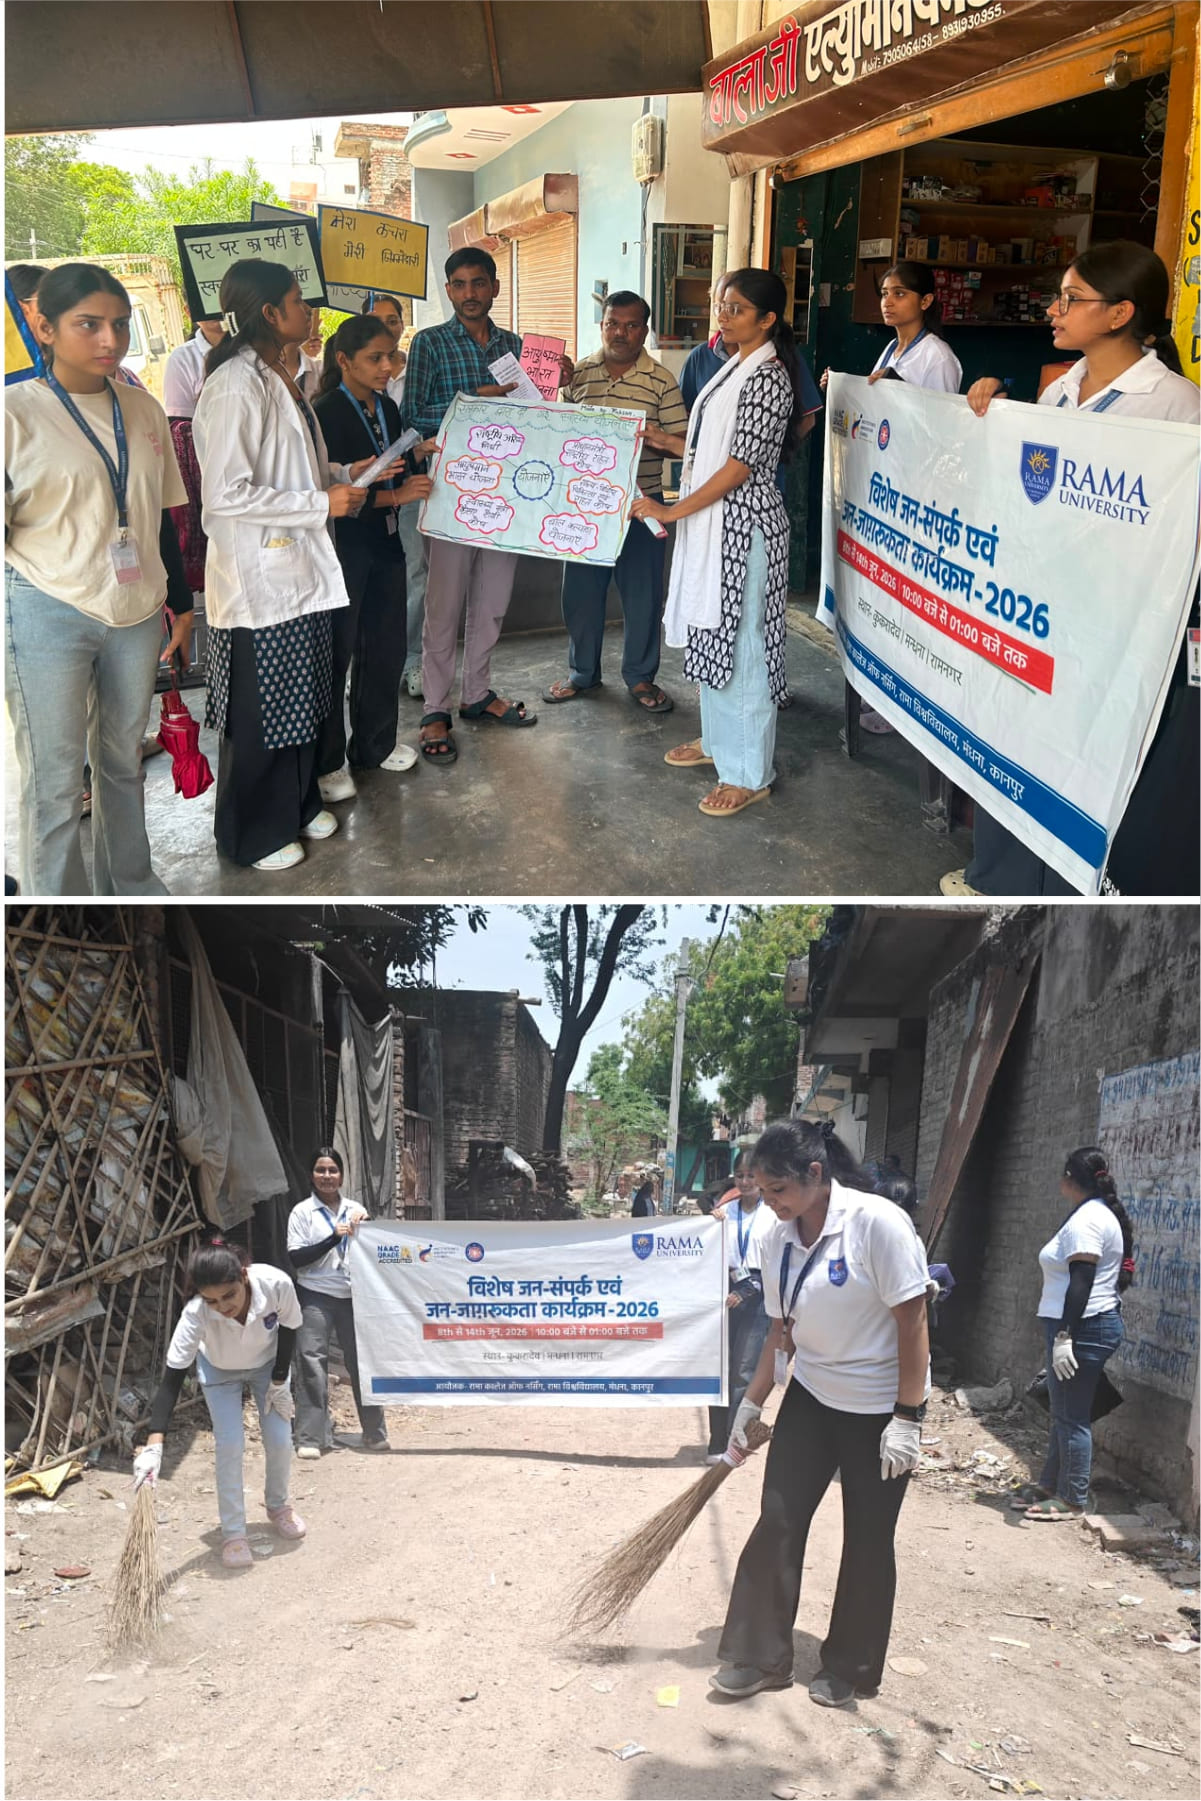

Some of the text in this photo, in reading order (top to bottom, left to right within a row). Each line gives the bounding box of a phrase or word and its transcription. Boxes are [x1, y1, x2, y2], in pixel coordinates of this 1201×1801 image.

[1025, 472, 1050, 486] RAMA
[1060, 458, 1151, 508] RAMA
[869, 471, 900, 519] विशेष
[965, 525, 999, 567] एवं
[1059, 490, 1150, 525] UNIVERSITY
[855, 549, 868, 570] 14th
[880, 569, 896, 591] 2026
[902, 584, 922, 608] 10:00
[924, 597, 938, 619] बजे
[939, 604, 949, 625] से
[950, 616, 978, 644] 01:00
[981, 628, 1001, 656] बजे
[1003, 644, 1028, 671] तक
[929, 653, 963, 687] रामनगर
[989, 762, 1025, 800] कानपुर
[657, 1236, 704, 1249] RAMA
[657, 1249, 704, 1257] UNIVERSITY
[467, 1274, 623, 1297] विशेष जन-संपर्क एवं
[466, 1327, 485, 1336] 14th
[505, 1328, 528, 1336] 2026
[535, 1327, 560, 1336] 10:00
